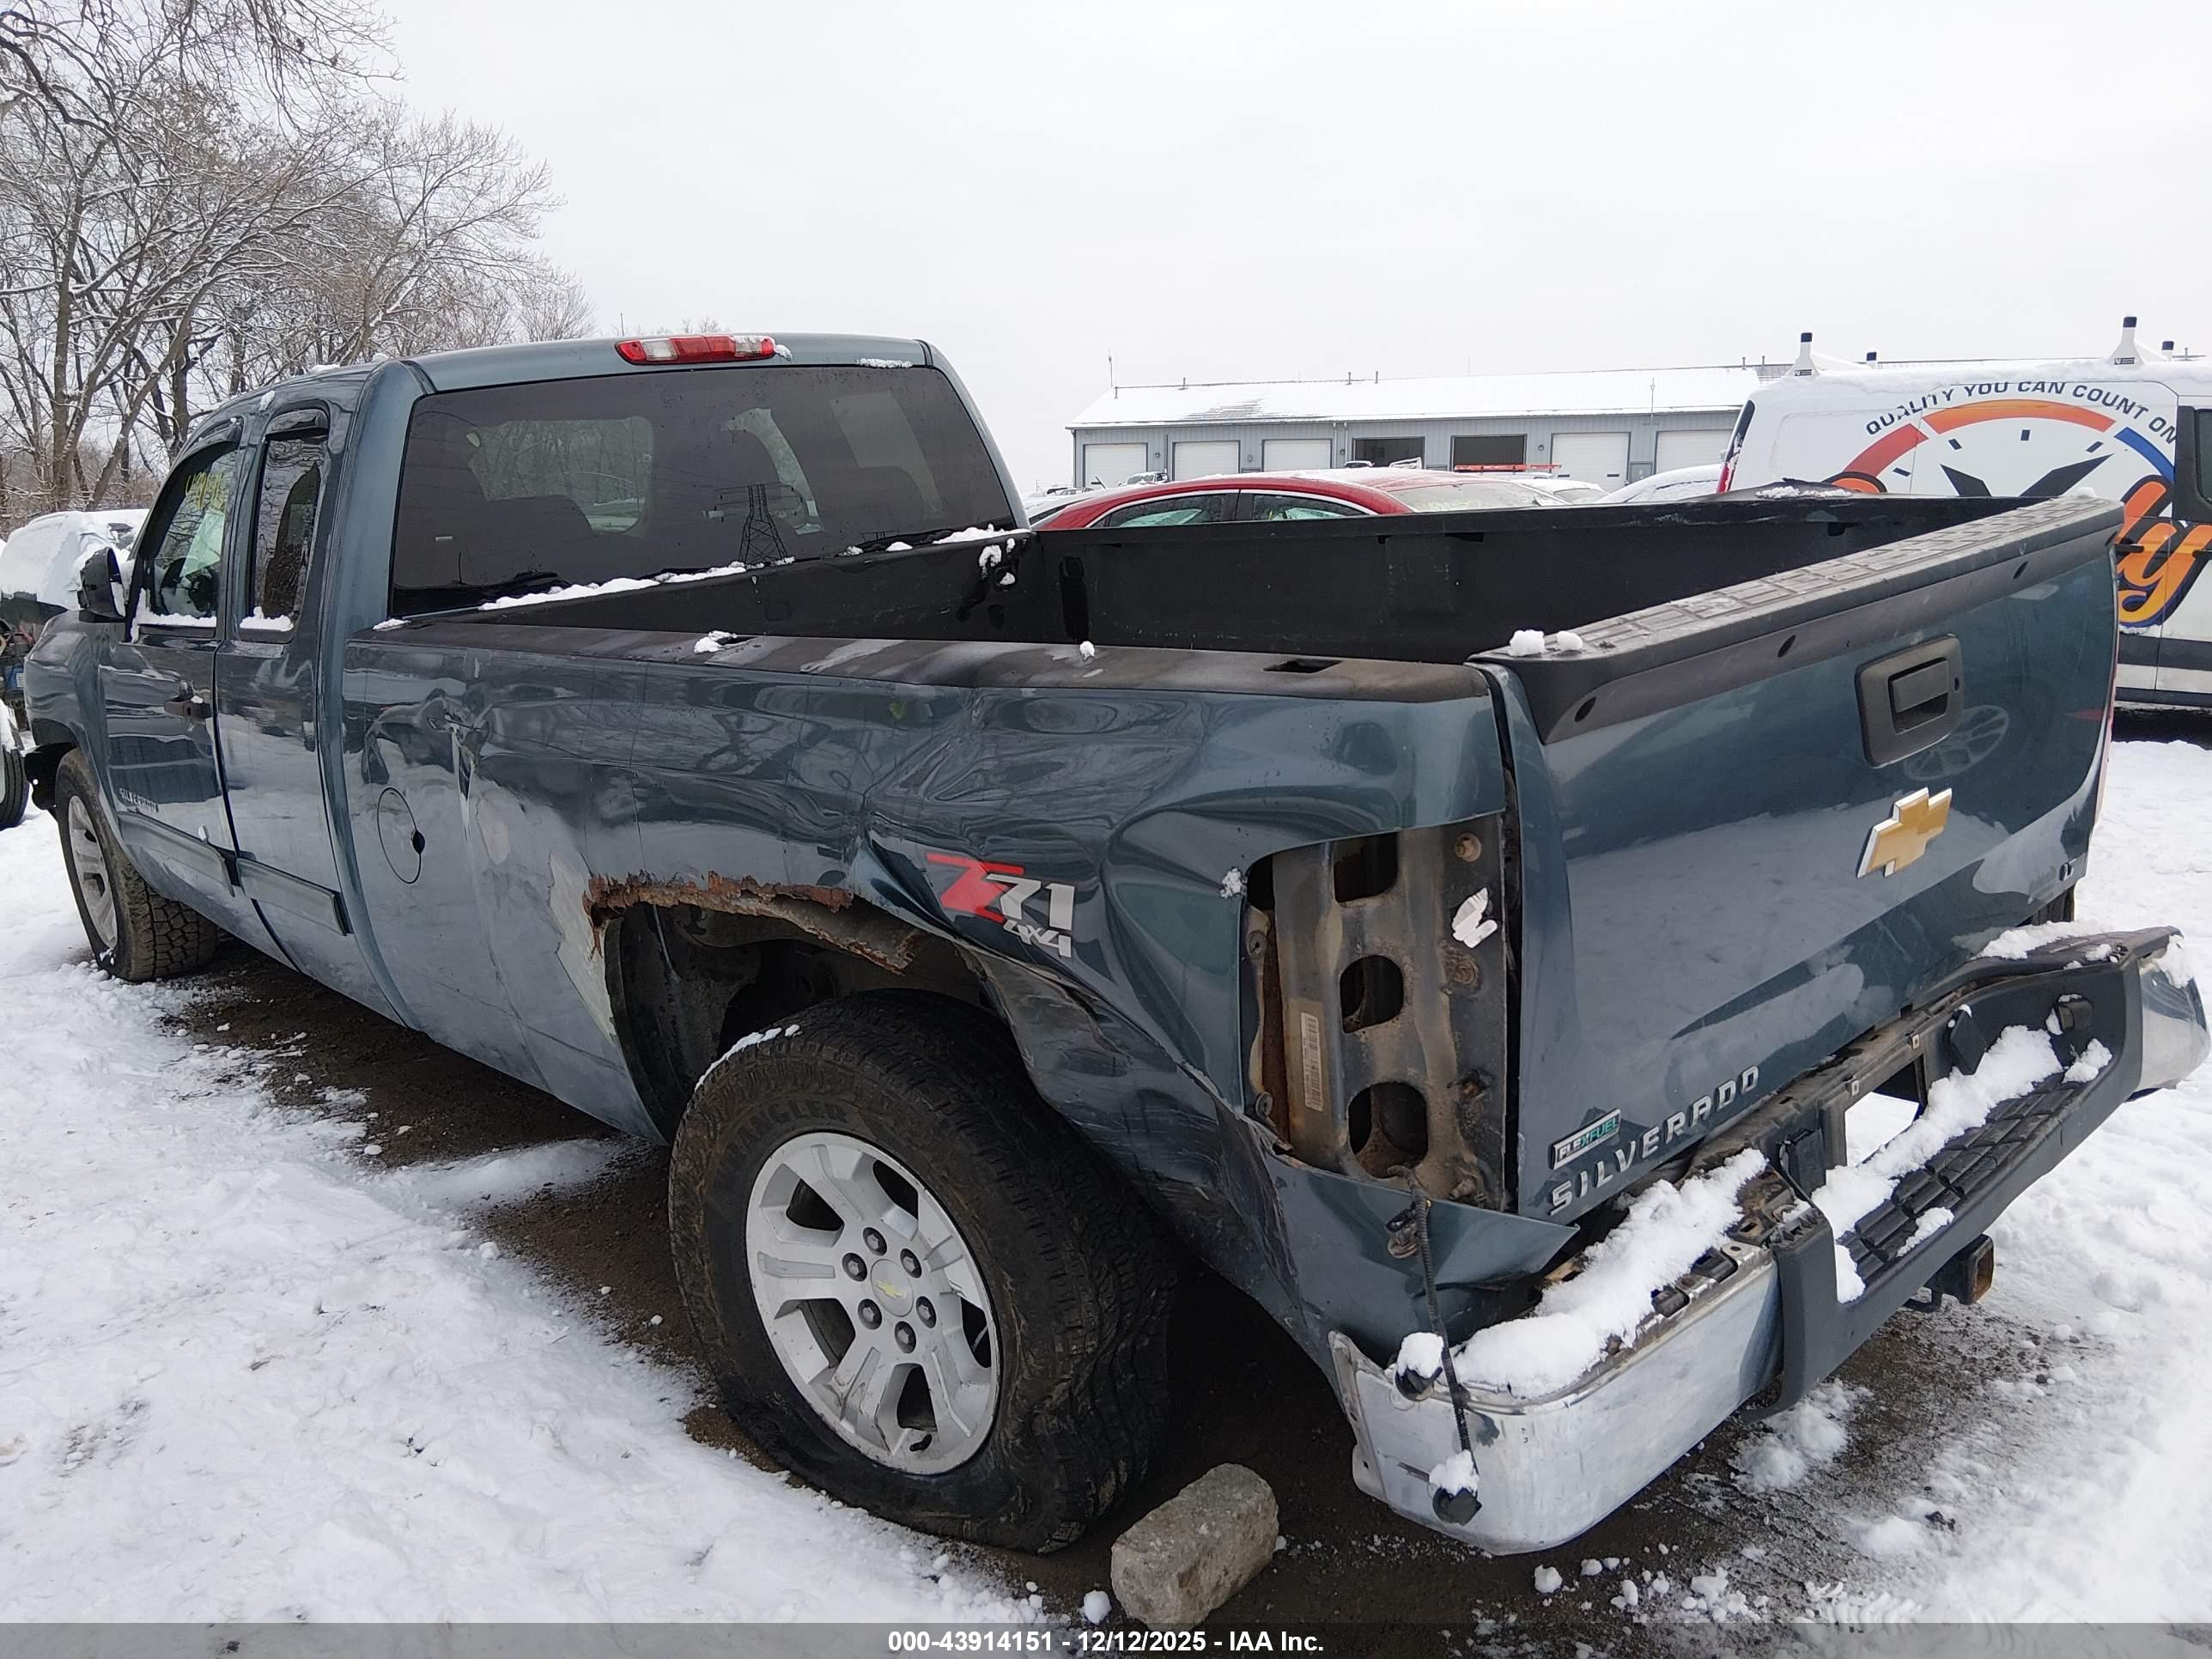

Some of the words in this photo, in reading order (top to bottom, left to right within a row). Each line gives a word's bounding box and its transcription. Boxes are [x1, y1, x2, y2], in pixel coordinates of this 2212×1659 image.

[1866, 388, 1954, 435] QUALITY
[1964, 381, 2009, 397] YOU
[2018, 381, 2067, 395] CAN
[2072, 384, 2148, 420] COUNT
[2148, 416, 2177, 445] ON
[926, 853, 1075, 930] Z71
[1549, 1066, 1759, 1216] SILVERADO
